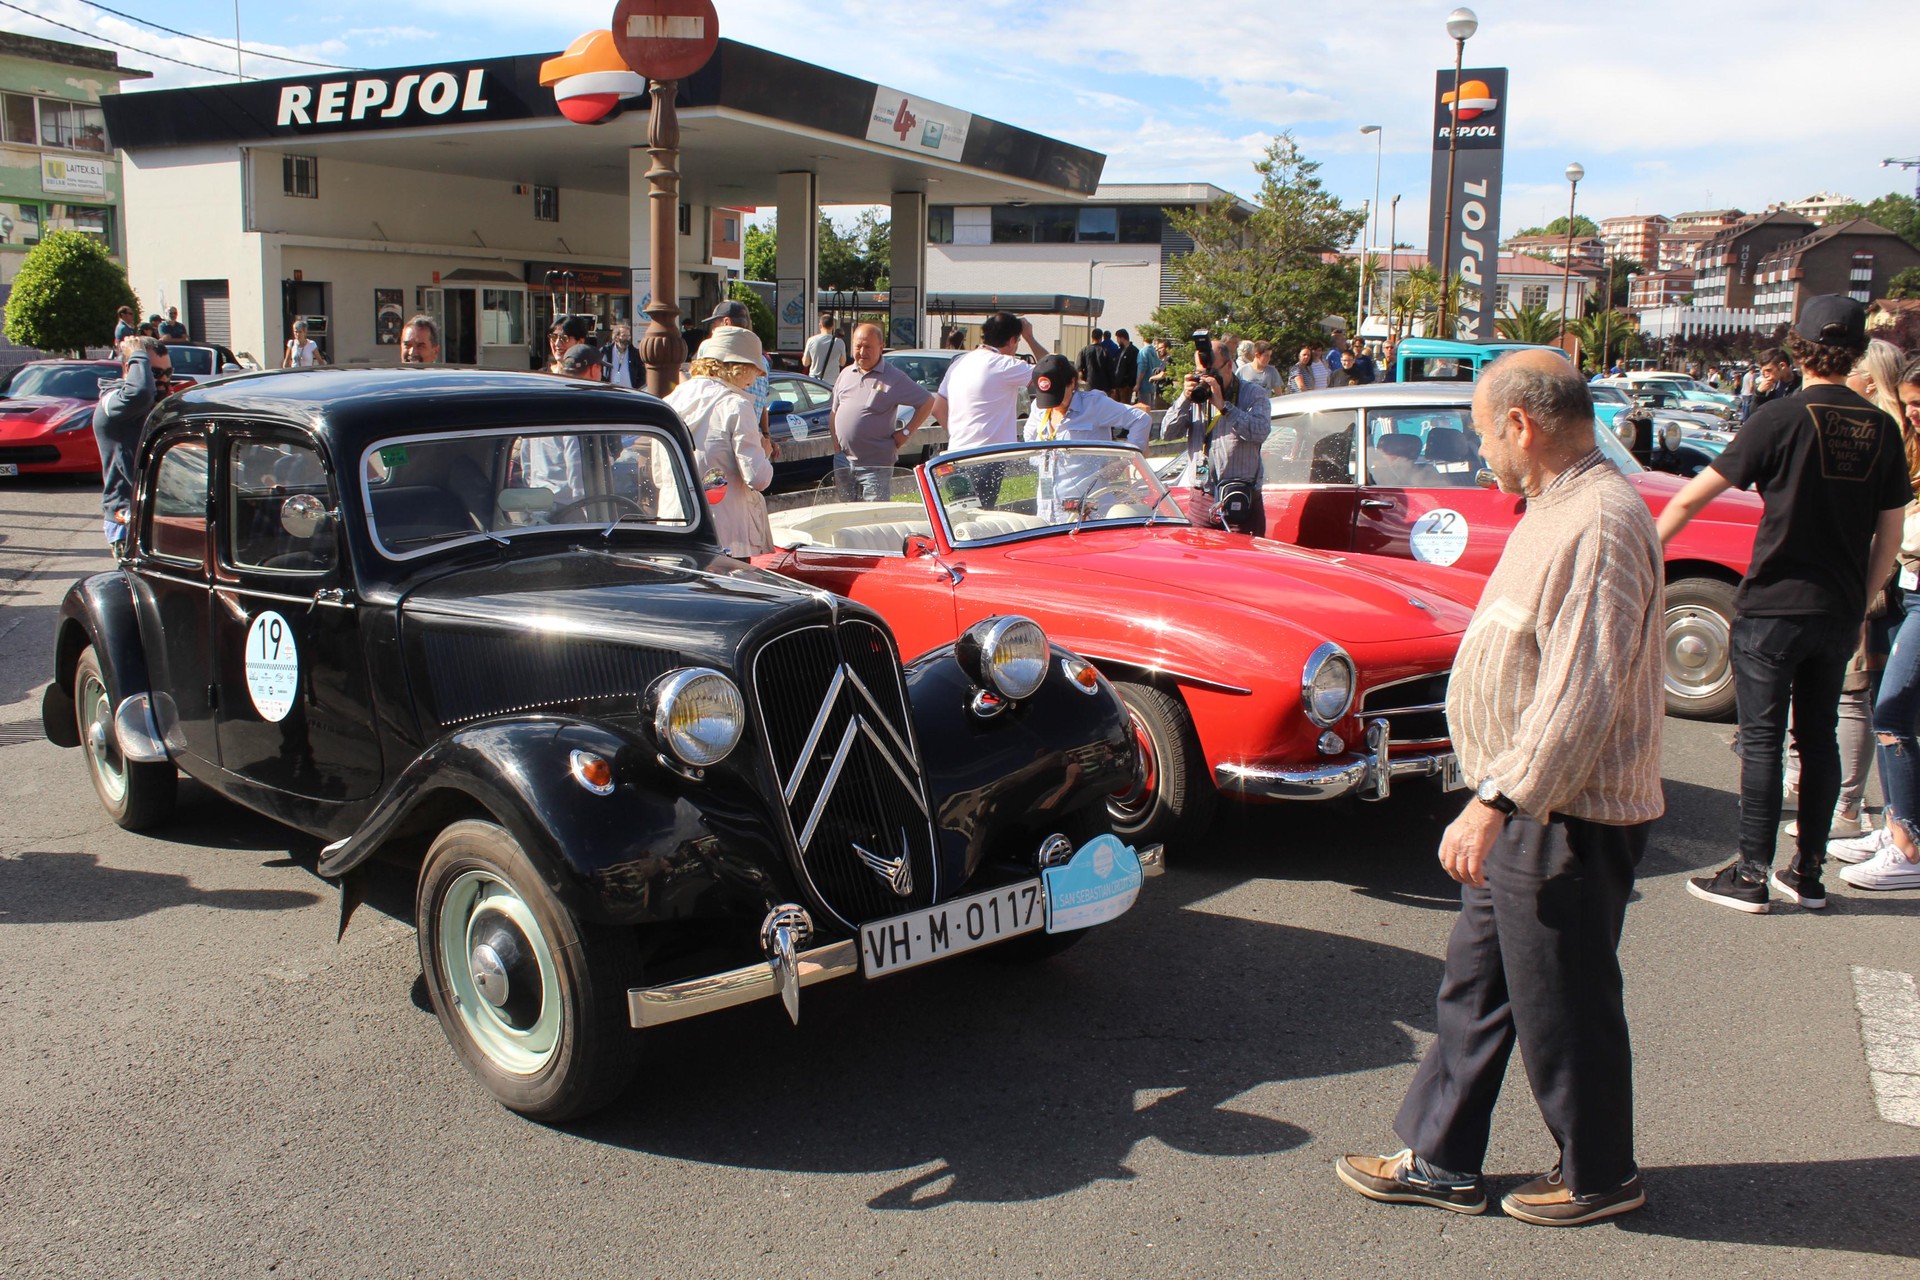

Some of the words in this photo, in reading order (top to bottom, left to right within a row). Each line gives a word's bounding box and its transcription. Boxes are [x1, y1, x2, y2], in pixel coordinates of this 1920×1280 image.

[277, 69, 488, 126] REPSOL
[1740, 244, 1750, 284] HOTEL
[1828, 438, 1872, 450] QUALITY
[1426, 512, 1456, 534] 22
[259, 618, 282, 660] 19
[1076, 885, 1111, 903] SEBASTIAN
